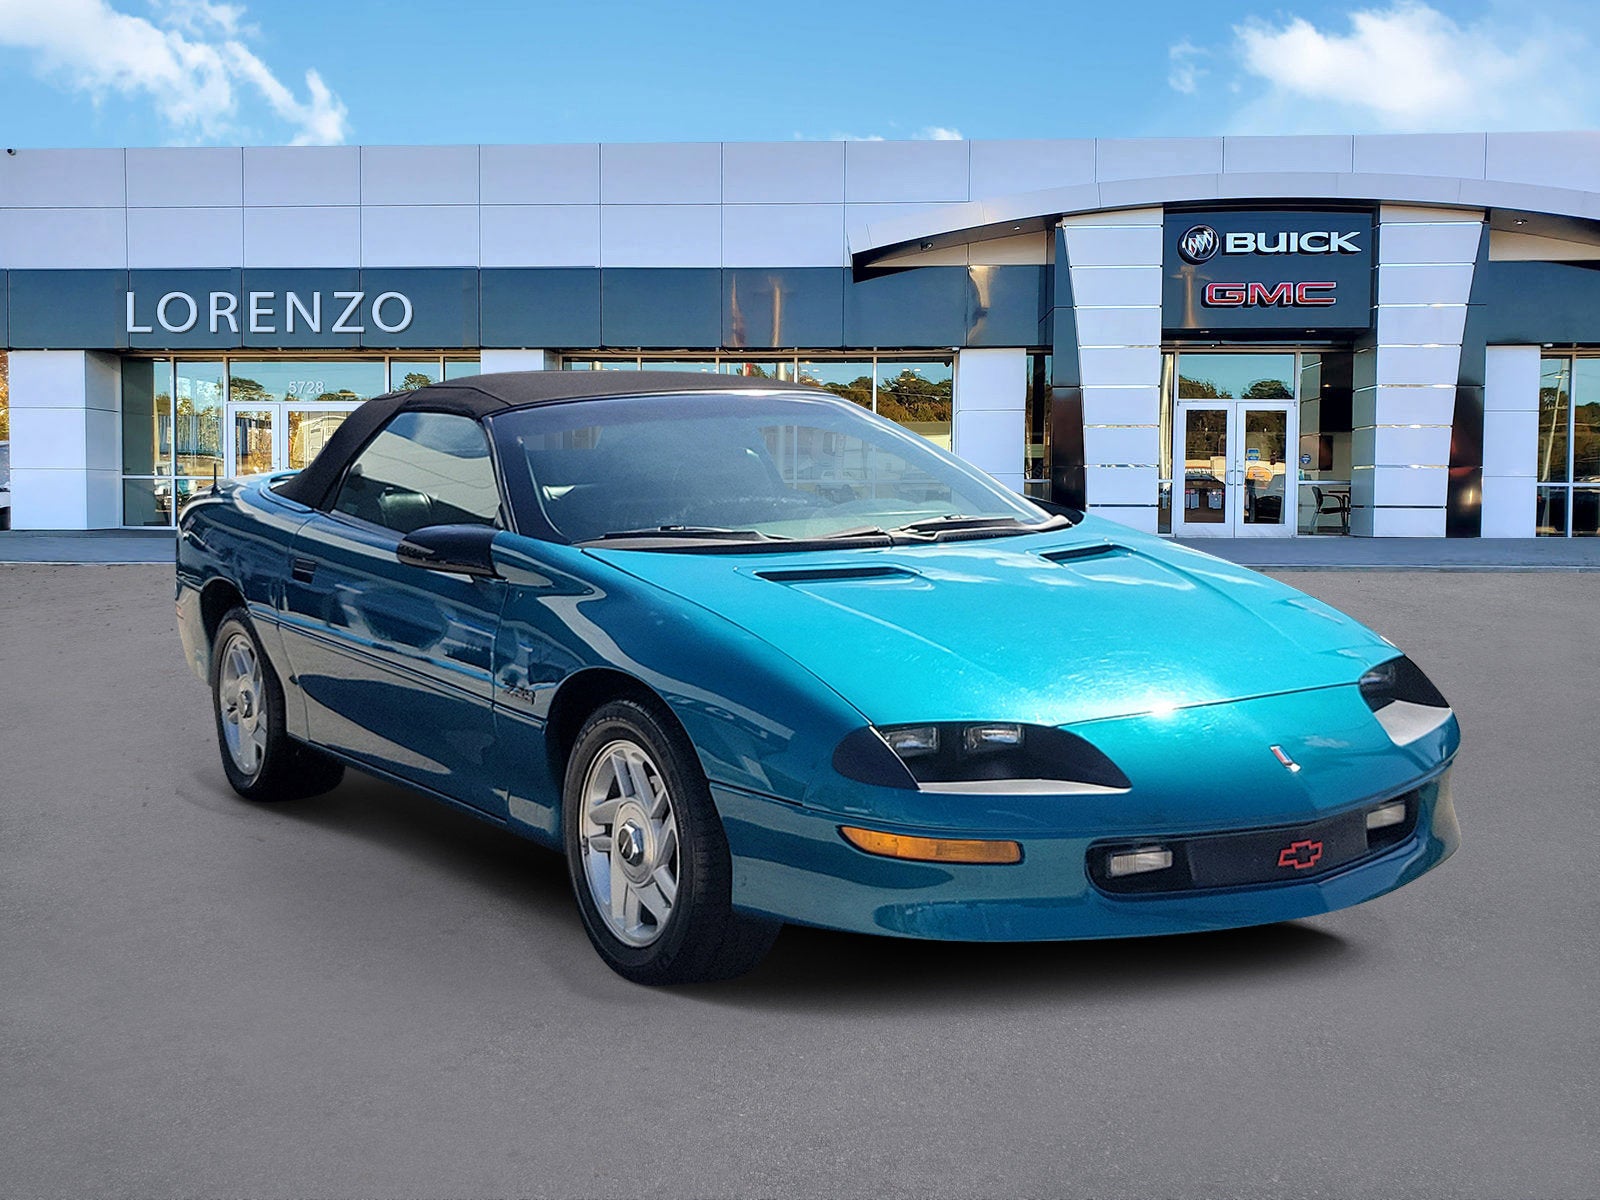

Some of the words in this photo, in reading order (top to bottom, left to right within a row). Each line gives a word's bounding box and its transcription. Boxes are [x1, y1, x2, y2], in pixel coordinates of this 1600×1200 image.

[1224, 231, 1362, 254] BUICK
[1204, 282, 1337, 305] GMC
[125, 291, 414, 334] LORENZO
[288, 380, 326, 394] 5728
